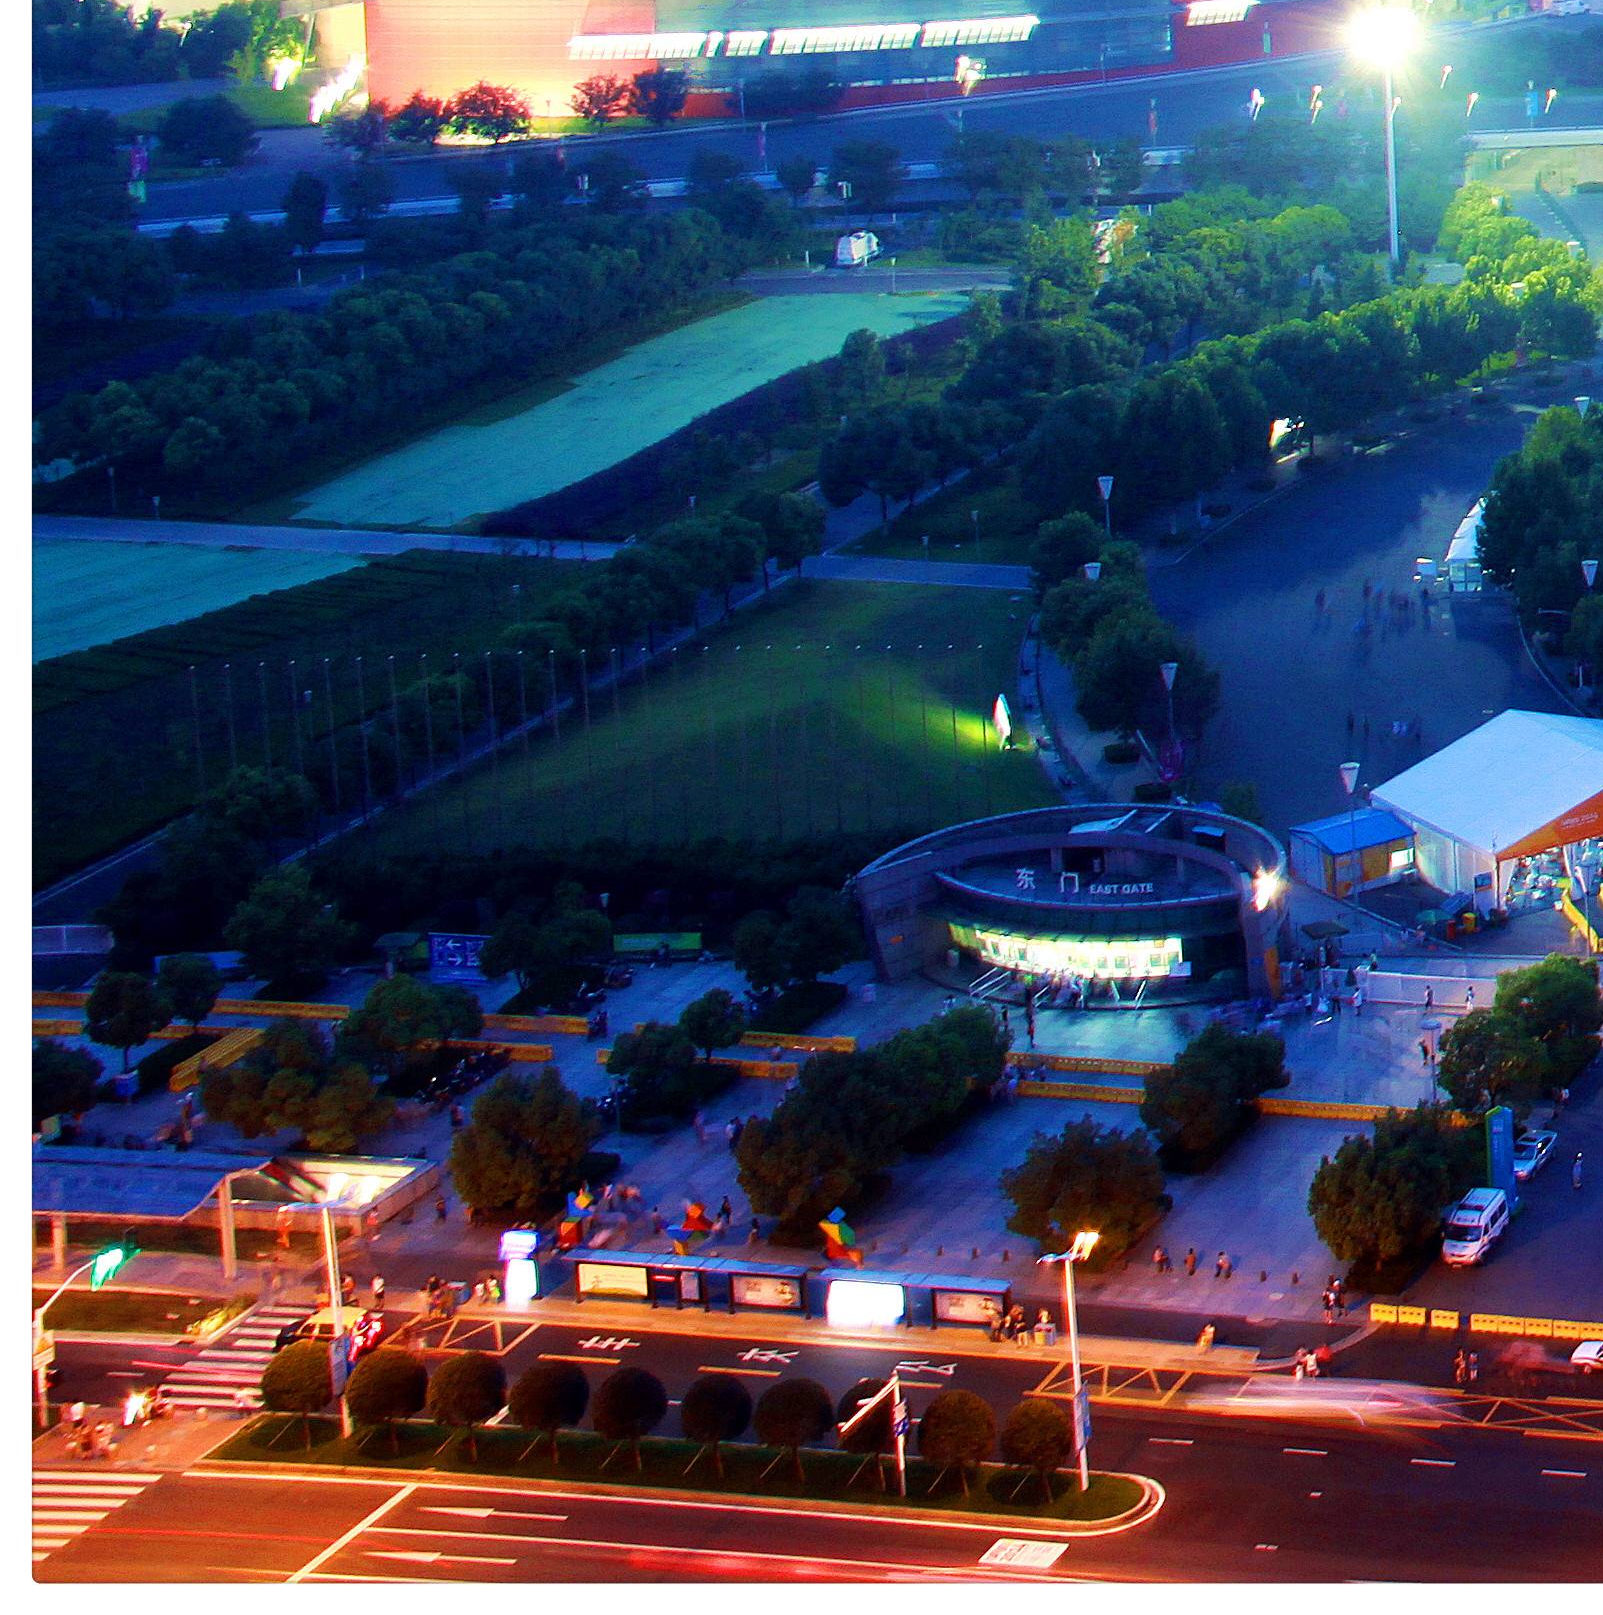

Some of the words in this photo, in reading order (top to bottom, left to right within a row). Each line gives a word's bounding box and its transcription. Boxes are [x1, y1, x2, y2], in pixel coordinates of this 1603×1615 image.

[1016, 867, 1079, 893] 东门
[1089, 884, 1119, 894] EAST
[1121, 883, 1153, 894] GATE
